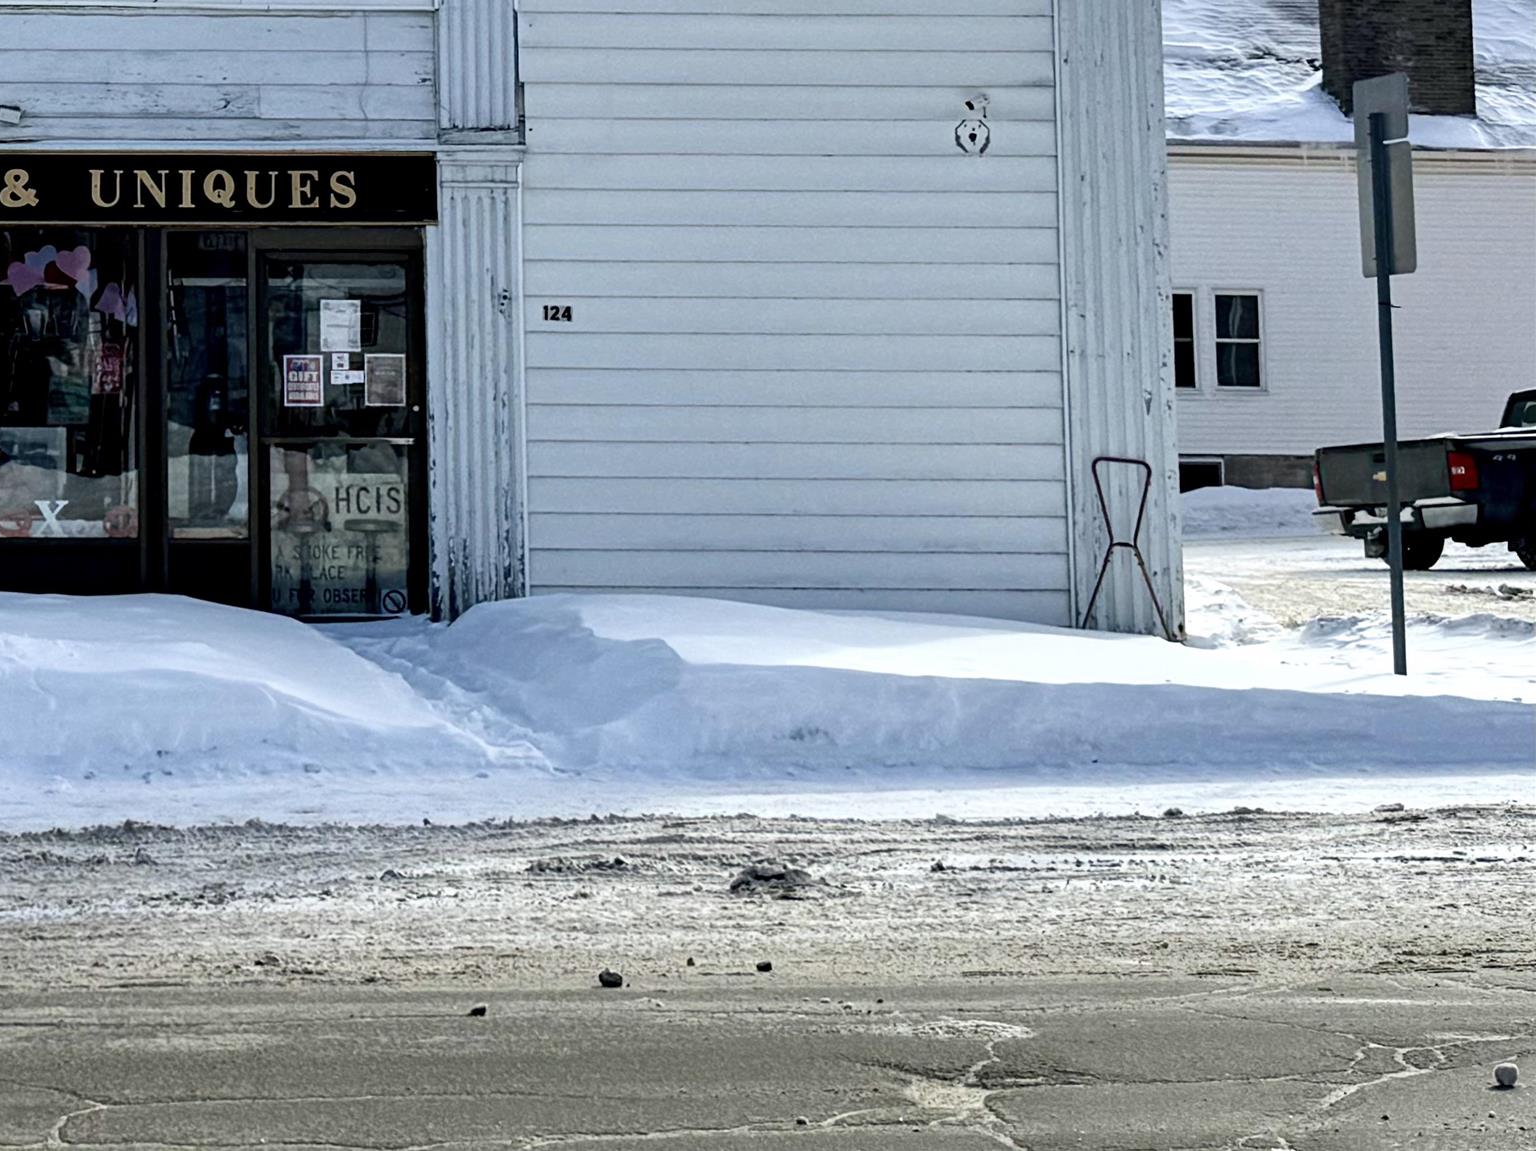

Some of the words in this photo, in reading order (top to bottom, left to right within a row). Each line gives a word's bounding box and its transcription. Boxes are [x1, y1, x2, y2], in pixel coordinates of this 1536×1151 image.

[0, 168, 40, 208] &
[88, 168, 358, 209] UNIQUES
[543, 305, 572, 322] 124
[288, 370, 319, 382] GIFT
[335, 487, 402, 514] HCIS
